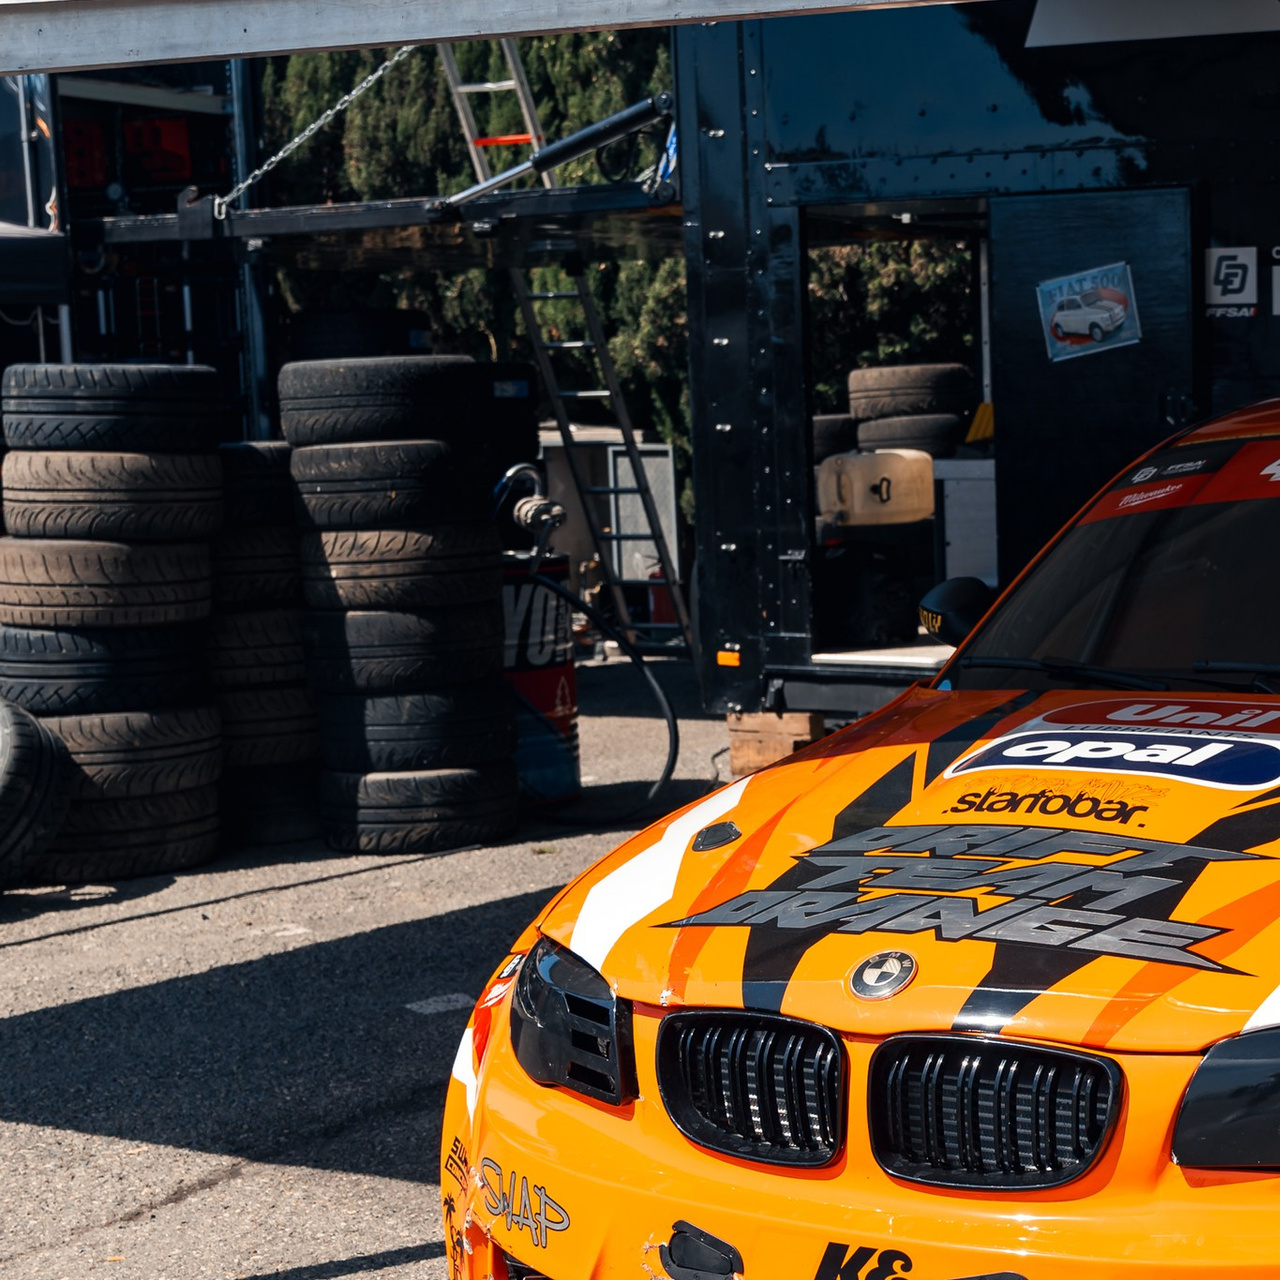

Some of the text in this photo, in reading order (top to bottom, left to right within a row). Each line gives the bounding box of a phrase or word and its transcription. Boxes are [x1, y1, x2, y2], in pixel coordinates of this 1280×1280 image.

[1049, 273, 1120, 298] FIAT 500
[1002, 740, 1234, 767] opal
[1062, 725, 1259, 739] LUBRIFIANTS
[802, 825, 1278, 874] DRIFT
[794, 855, 1185, 914] TEAM
[658, 890, 1254, 977] ORANGE
[481, 1156, 570, 1249] SWAP
